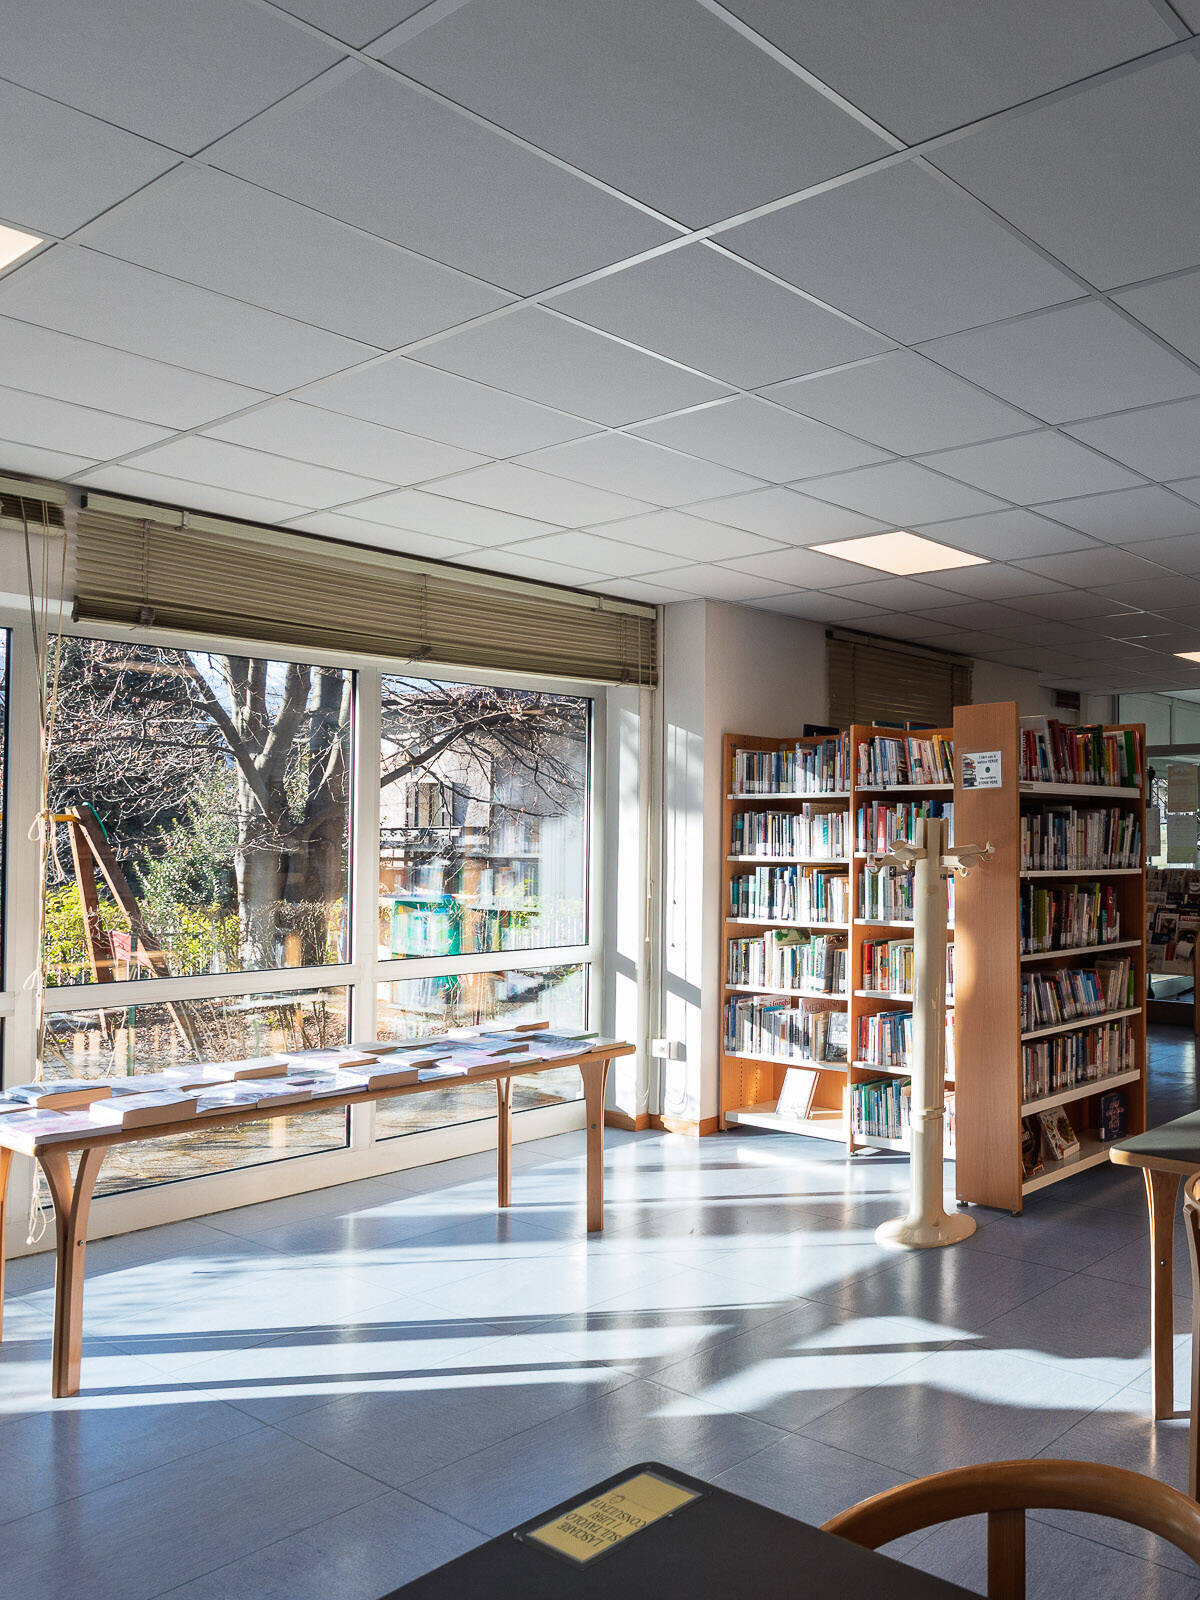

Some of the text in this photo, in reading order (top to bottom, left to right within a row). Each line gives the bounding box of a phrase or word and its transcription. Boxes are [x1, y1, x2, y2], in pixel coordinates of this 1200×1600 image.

[805, 1000, 840, 1013] MEDICINA
[589, 1511, 613, 1526] LIBRI
[590, 1499, 647, 1527] CONSULTATI
[556, 1521, 604, 1548] LASCIARE
[565, 1513, 622, 1543] SUL TAVOLO
